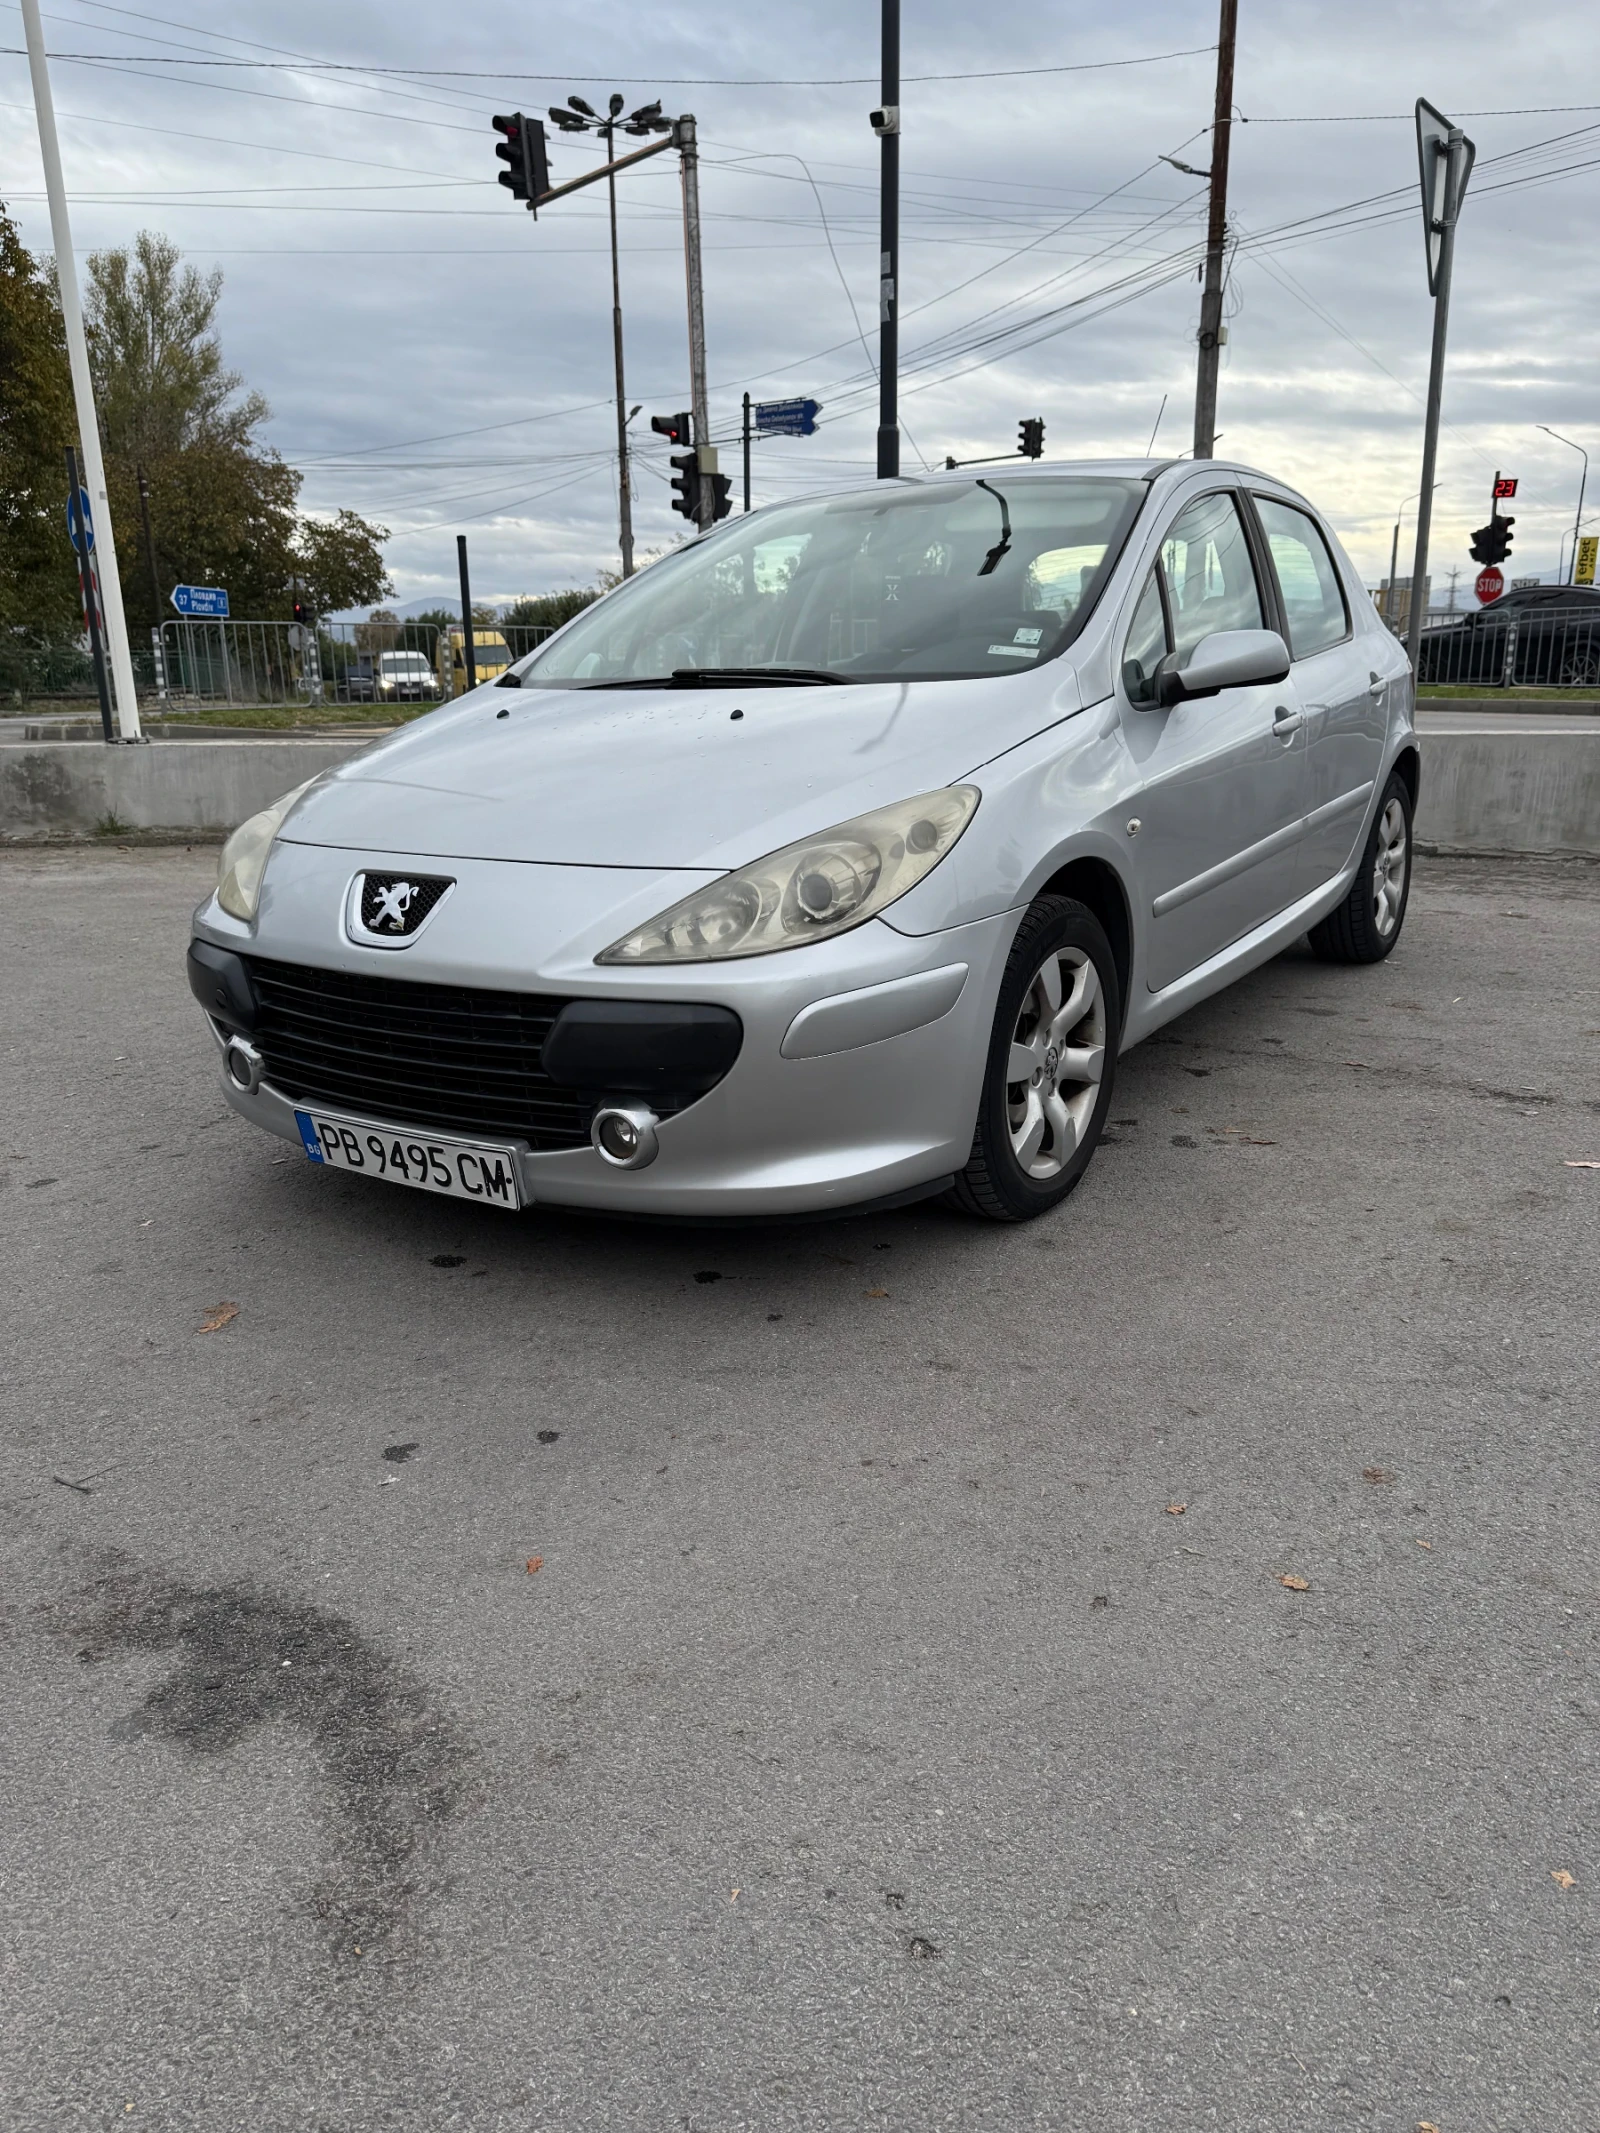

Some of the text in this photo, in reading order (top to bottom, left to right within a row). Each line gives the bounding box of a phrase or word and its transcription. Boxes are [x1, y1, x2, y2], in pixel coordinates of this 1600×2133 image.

[1495, 480, 1515, 497] 23
[1578, 539, 1591, 575] efbet
[1477, 578, 1503, 593] STOP
[179, 594, 188, 605] 37
[190, 588, 216, 601] Пловдив
[191, 600, 214, 612] Plovdiv
[306, 1141, 321, 1156] BG
[317, 1122, 510, 1201] PB 9495 CM
